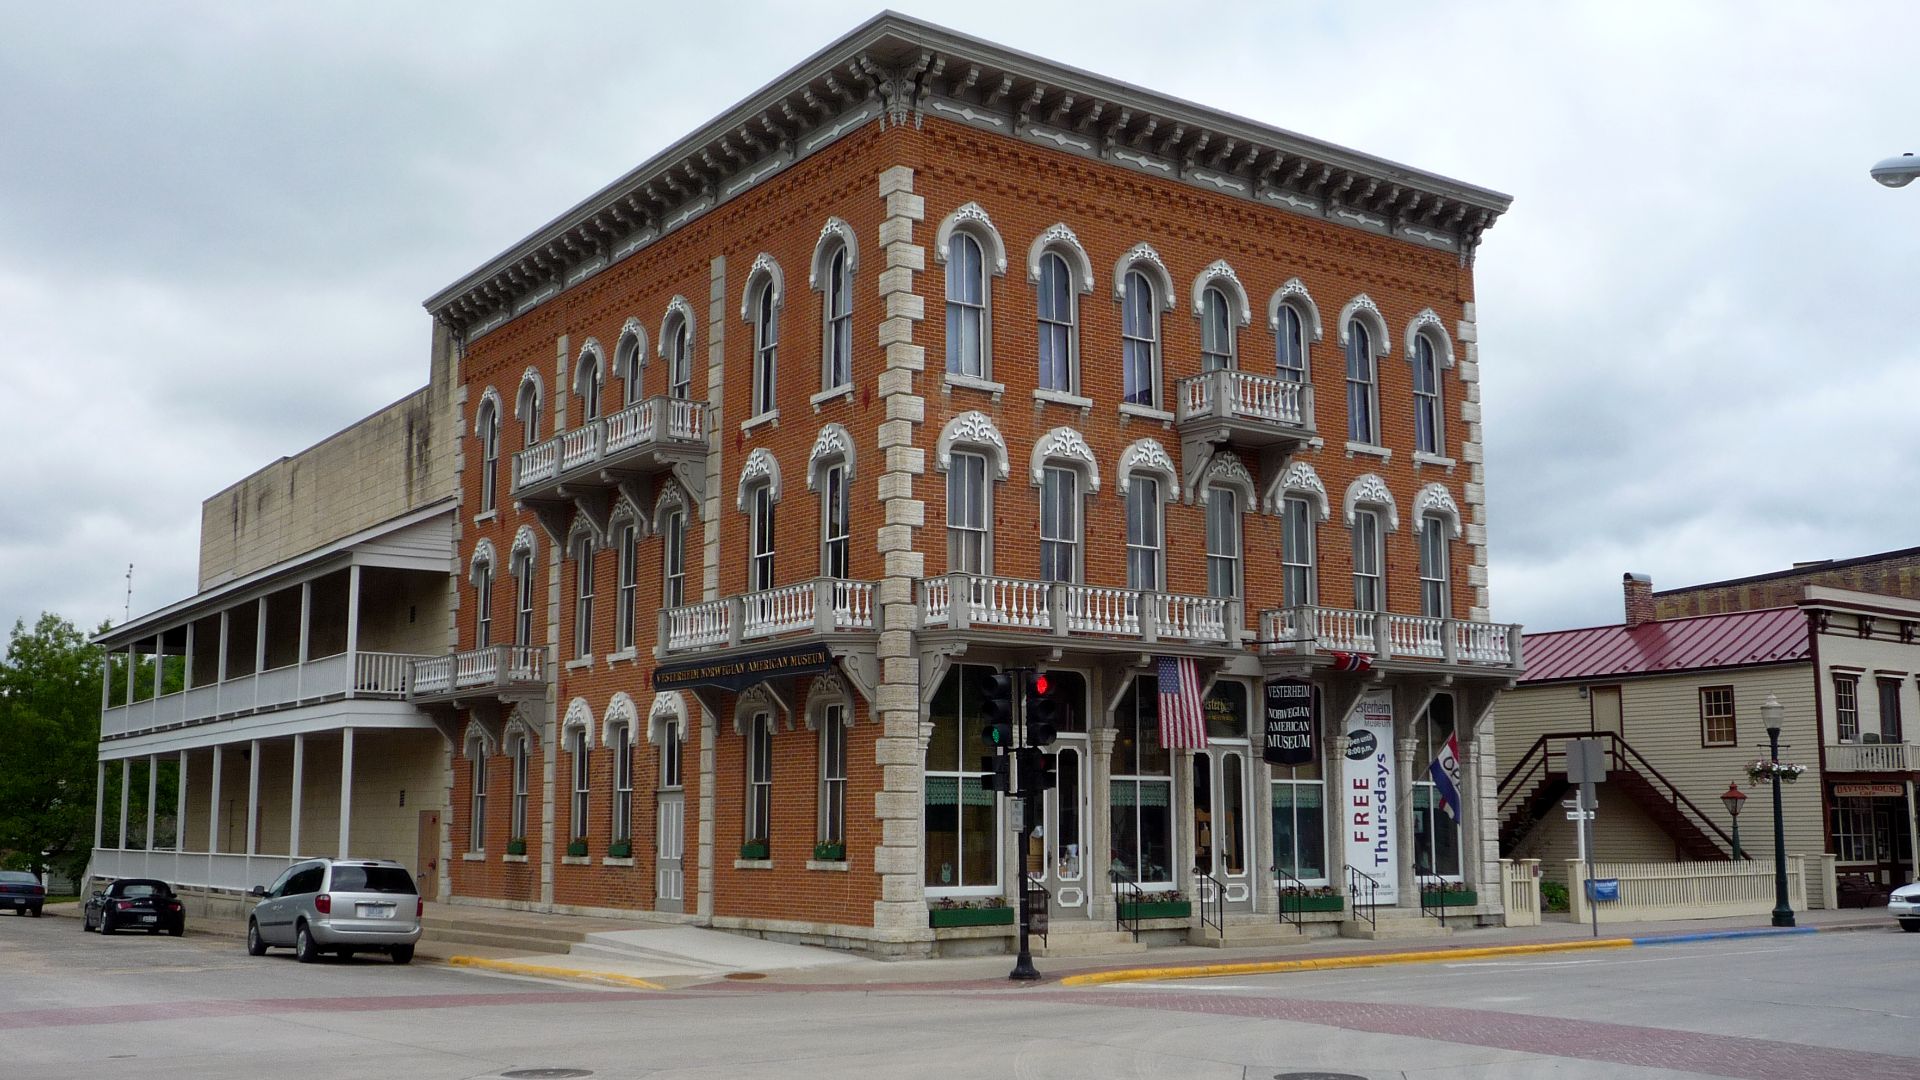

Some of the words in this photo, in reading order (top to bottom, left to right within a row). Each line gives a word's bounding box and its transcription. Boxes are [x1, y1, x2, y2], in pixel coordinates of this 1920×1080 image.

[656, 668, 699, 682] VESTERHEIM
[701, 662, 744, 678] NORWEGIAN
[748, 655, 788, 672] AMERICAN
[791, 652, 825, 666] MUSEUM
[1267, 685, 1310, 698] VESTERHEIM
[1268, 706, 1310, 719] NORWEGIAN
[1356, 700, 1391, 714] esterheim
[1268, 721, 1310, 731] AMERICAN
[1267, 734, 1310, 749] MUSEUM
[1837, 785, 1869, 793] DAYTON
[1872, 785, 1900, 793] HOUSE
[1353, 778, 1370, 842] FREE
[1374, 753, 1389, 867] Thursdays
